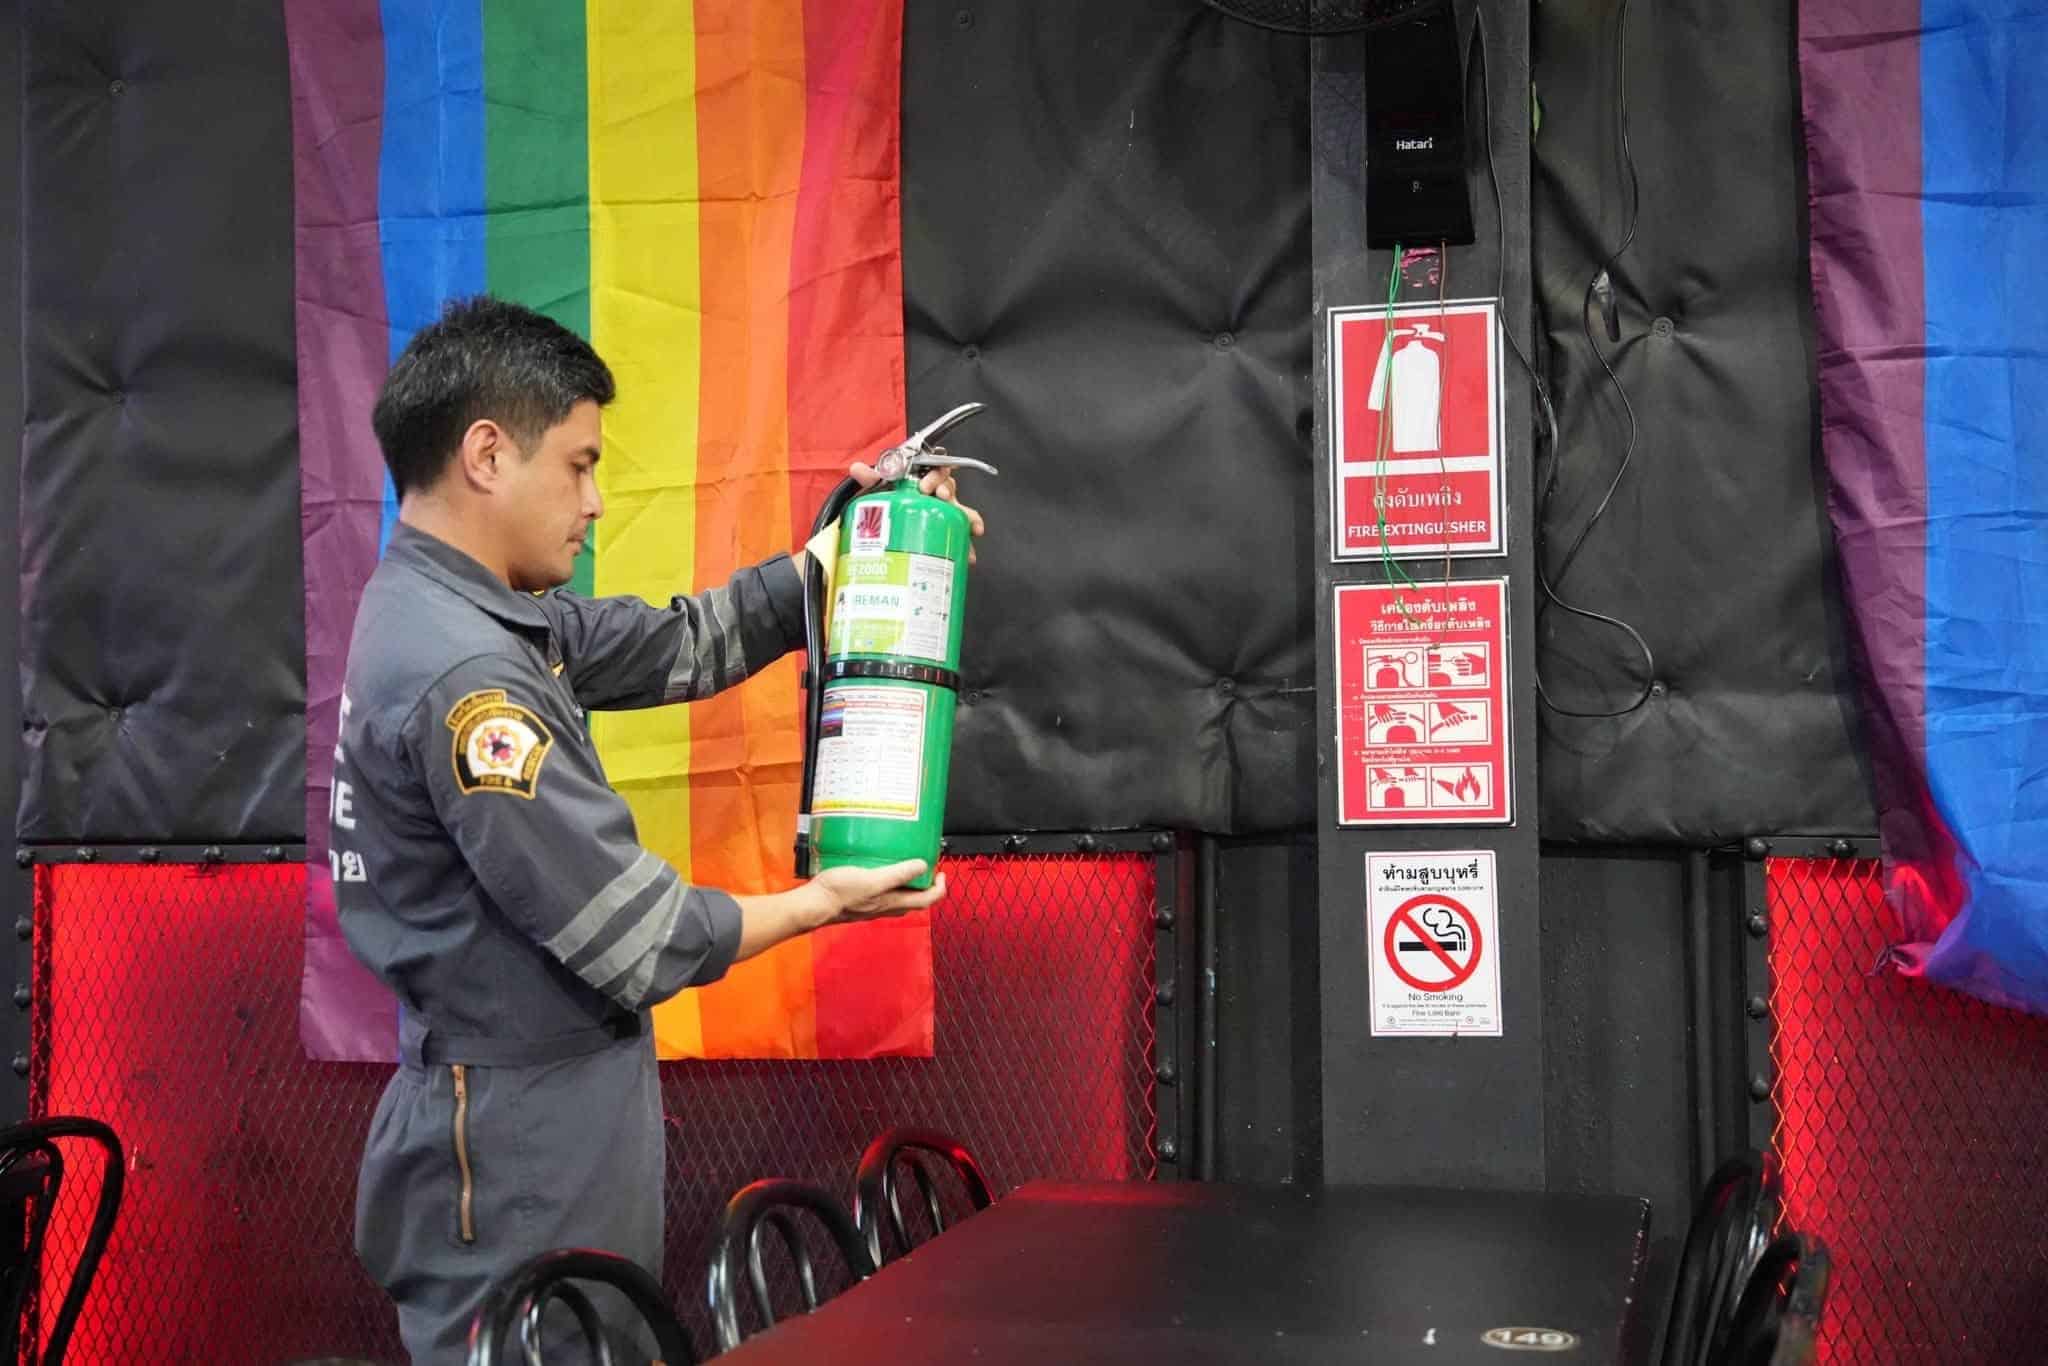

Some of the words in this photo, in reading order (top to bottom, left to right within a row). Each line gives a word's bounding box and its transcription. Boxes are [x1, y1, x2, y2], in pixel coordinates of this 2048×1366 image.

[1396, 136, 1433, 151] Hatari
[1347, 525, 1379, 538] FIRE
[1382, 858, 1479, 885] ห้ามสูบบุหรี่
[1408, 992, 1422, 1001] No
[1423, 991, 1464, 1003] Smoking
